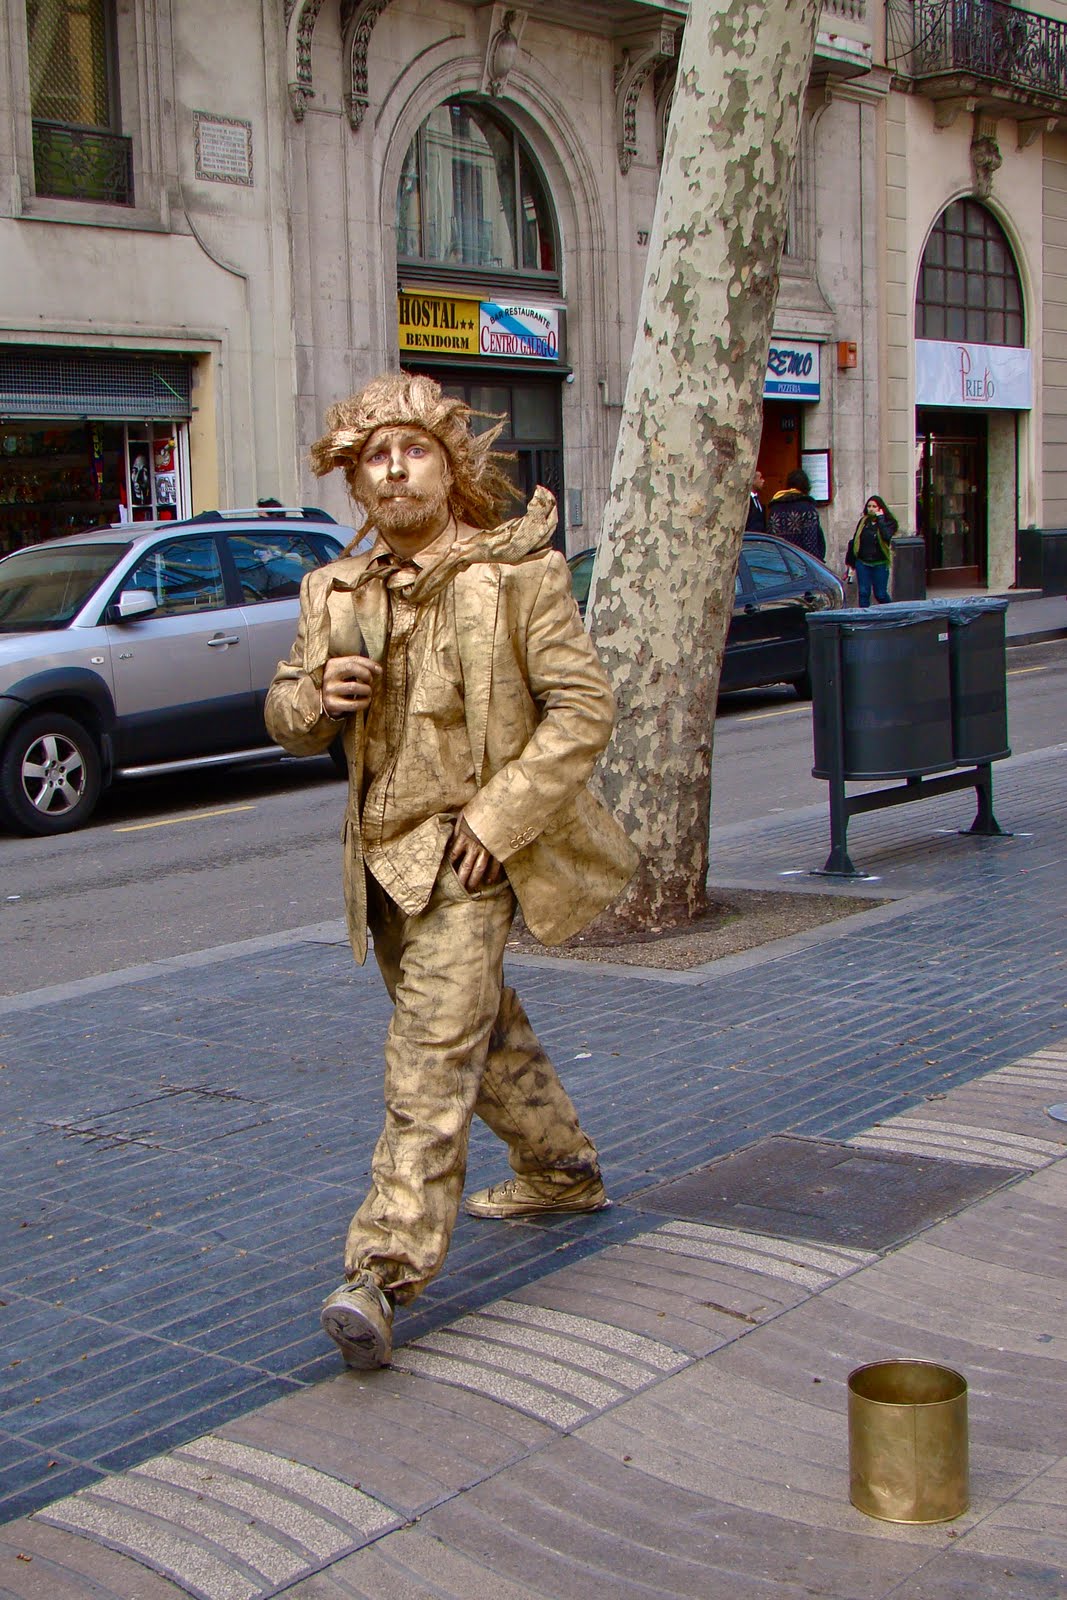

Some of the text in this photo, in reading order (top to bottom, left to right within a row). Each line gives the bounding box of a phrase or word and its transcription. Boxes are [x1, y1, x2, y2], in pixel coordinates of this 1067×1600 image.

[637, 230, 649, 246] 37
[399, 298, 459, 330] HOSTAL
[489, 308, 551, 330] BAR RESTAURANTE
[406, 334, 469, 349] BENIDORM
[481, 326, 555, 357] CENTRO GALEGO
[767, 349, 812, 376] REMO
[777, 384, 801, 393] PIZZERIA
